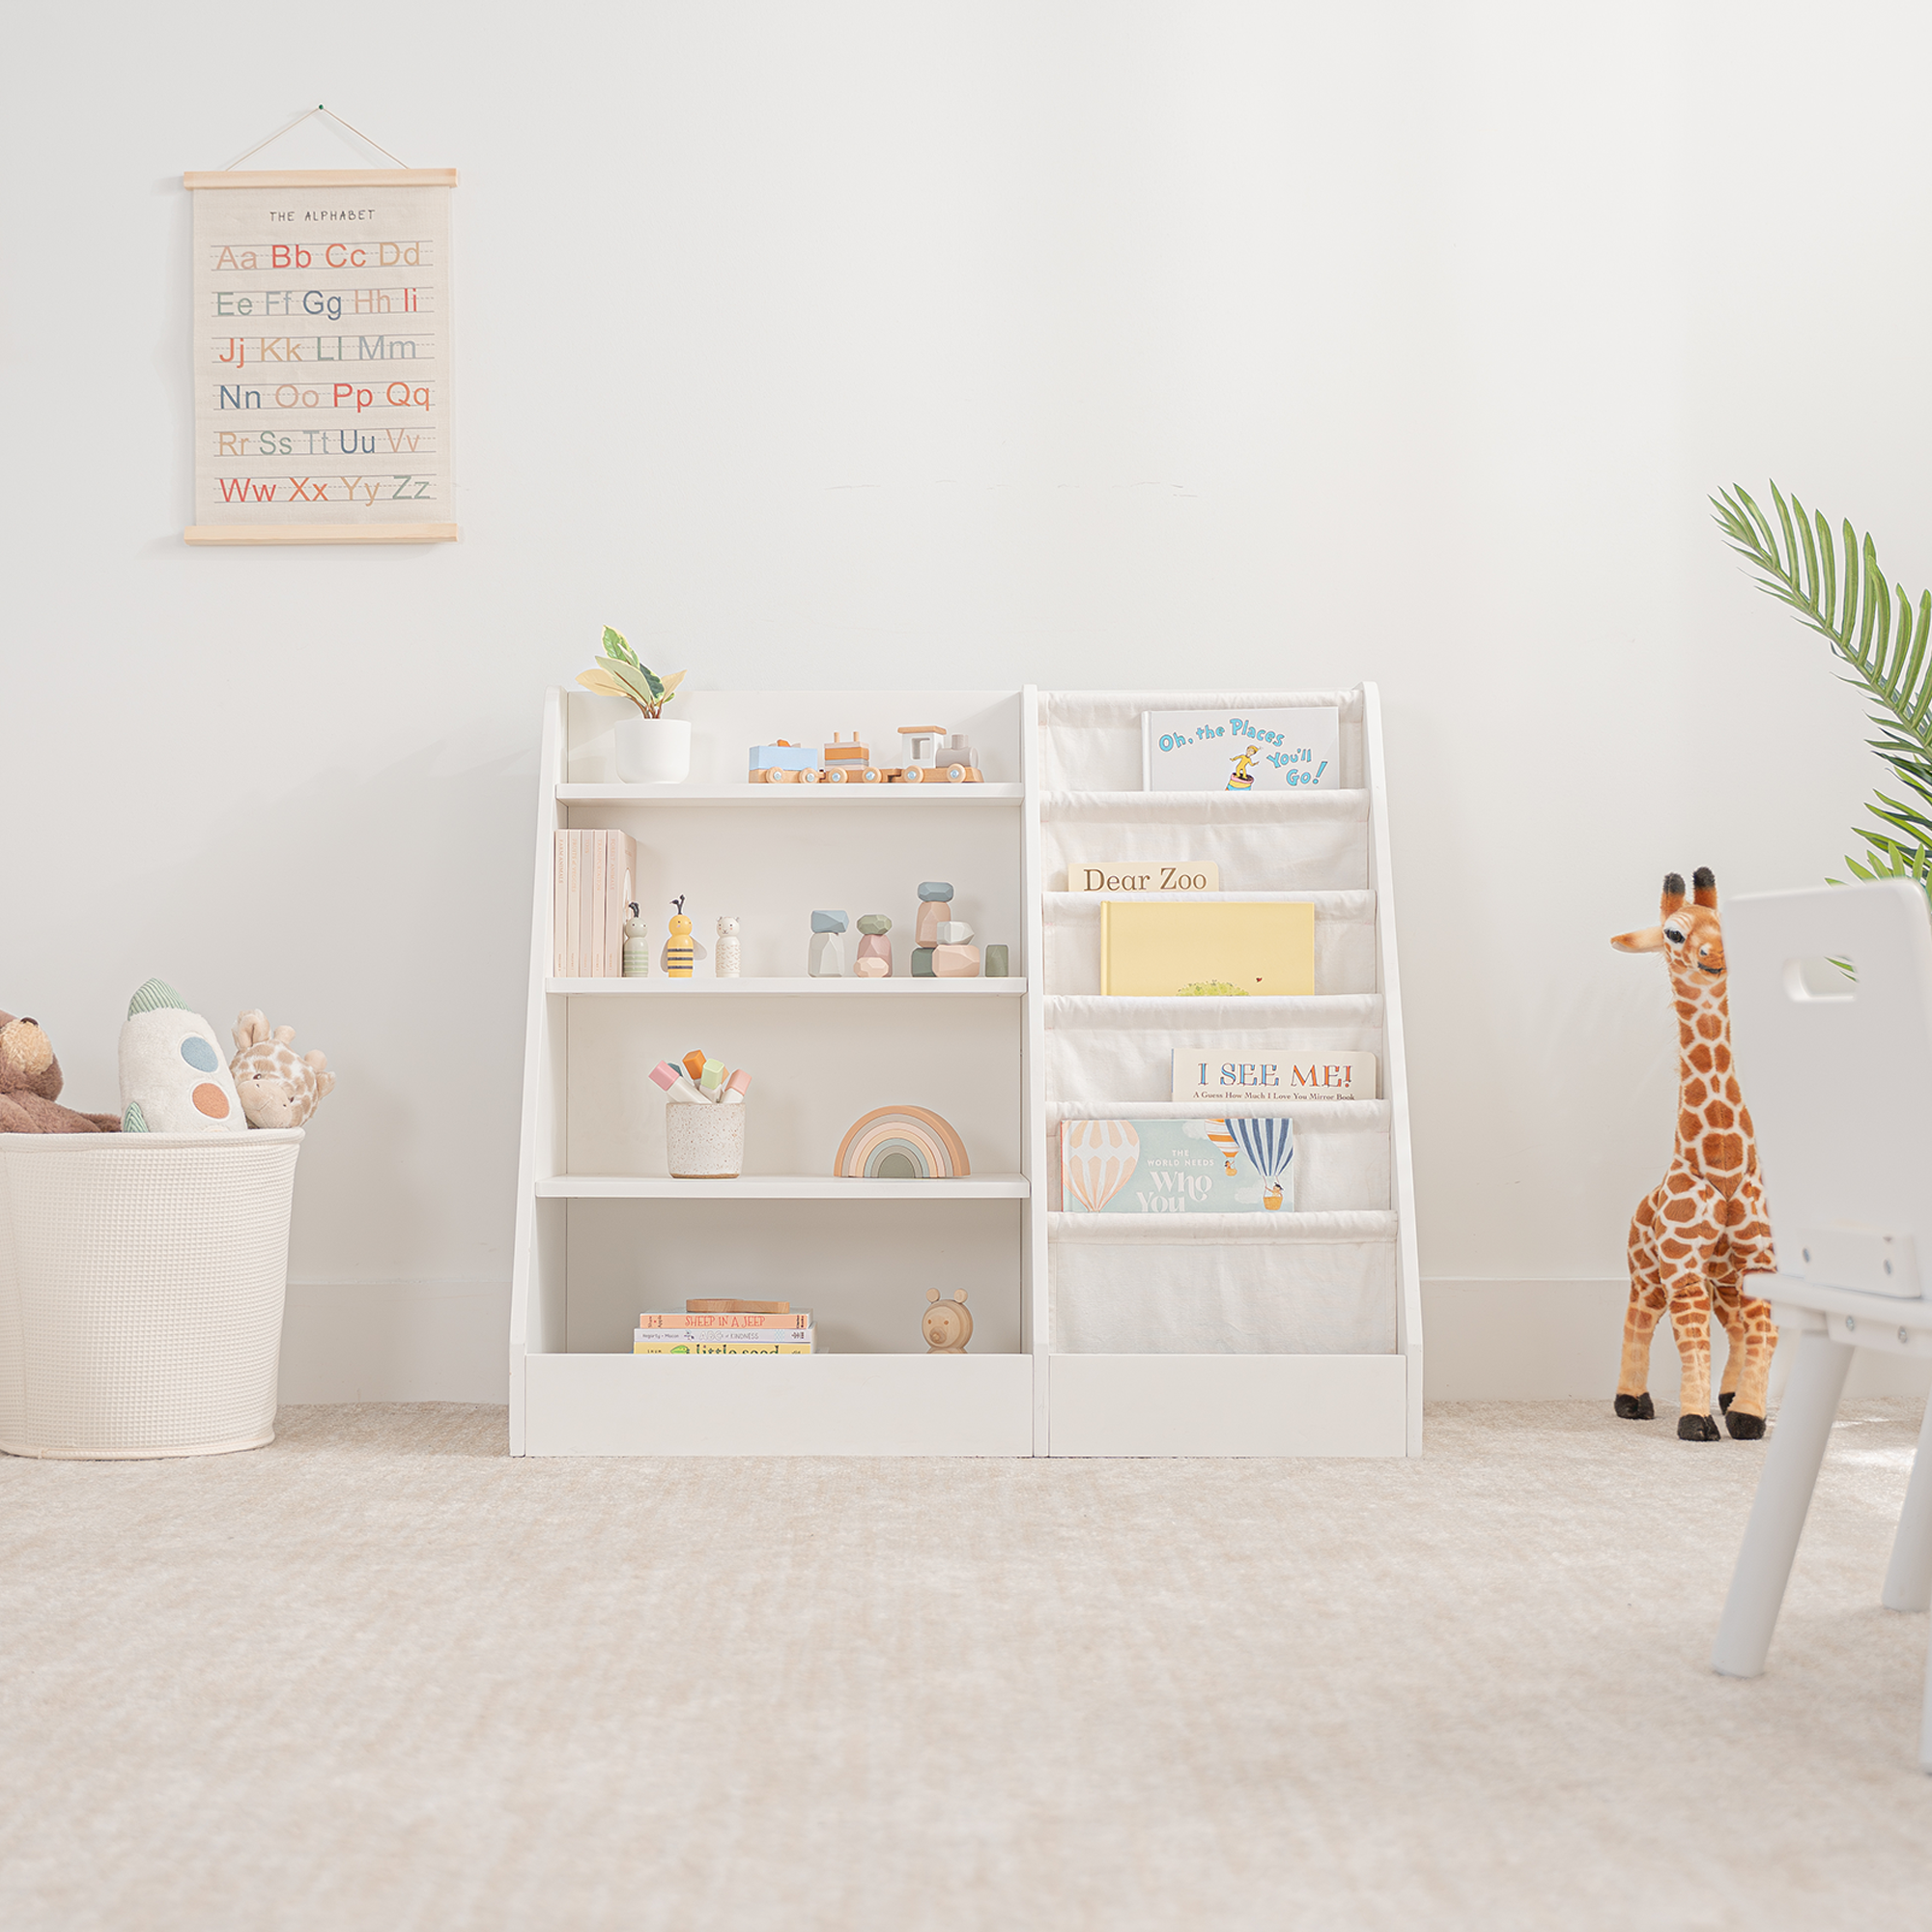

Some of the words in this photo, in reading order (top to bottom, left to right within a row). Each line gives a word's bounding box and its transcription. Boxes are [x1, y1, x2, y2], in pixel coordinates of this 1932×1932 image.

[270, 211, 296, 222] THE
[304, 209, 376, 222] ALPHABET
[216, 245, 258, 270] Aa
[271, 244, 312, 269] Bb
[326, 243, 366, 268] Cc
[380, 242, 419, 267] Dd
[217, 292, 253, 316] Ee
[266, 291, 293, 315] Ff
[302, 290, 342, 321] Gg
[355, 289, 391, 314] Hh
[219, 337, 244, 369] Jj
[261, 337, 302, 362] Kk
[317, 336, 342, 361] Ll
[358, 335, 416, 360] Mm
[220, 384, 261, 410] Nn
[275, 384, 319, 409] Oo
[333, 384, 373, 413] Pp
[386, 382, 430, 412] Qq
[219, 432, 249, 456] Rr
[260, 430, 293, 456] Ss
[302, 430, 329, 455] Tt
[340, 430, 375, 454] Uu
[386, 429, 419, 453] Vv
[219, 478, 276, 502] Ww
[289, 477, 329, 502] Xx
[340, 476, 381, 507] Yy
[392, 475, 431, 499] Zz
[1158, 731, 1194, 753] Oh,
[1195, 724, 1226, 740] the
[1229, 718, 1285, 748] Places
[1266, 748, 1312, 769] You'll
[1286, 760, 1328, 786] Go!
[1083, 868, 1151, 892] Dear
[1159, 867, 1207, 890] Zoo
[1197, 1063, 1208, 1086] I
[1219, 1063, 1280, 1087] SEE
[1291, 1065, 1353, 1088] ME!
[1150, 1171, 1213, 1203] Who
[1136, 1191, 1185, 1212] You
[685, 1315, 716, 1326] SHEEP
[718, 1315, 729, 1326] IN
[730, 1316, 740, 1328] A
[741, 1315, 766, 1328] JEEP
